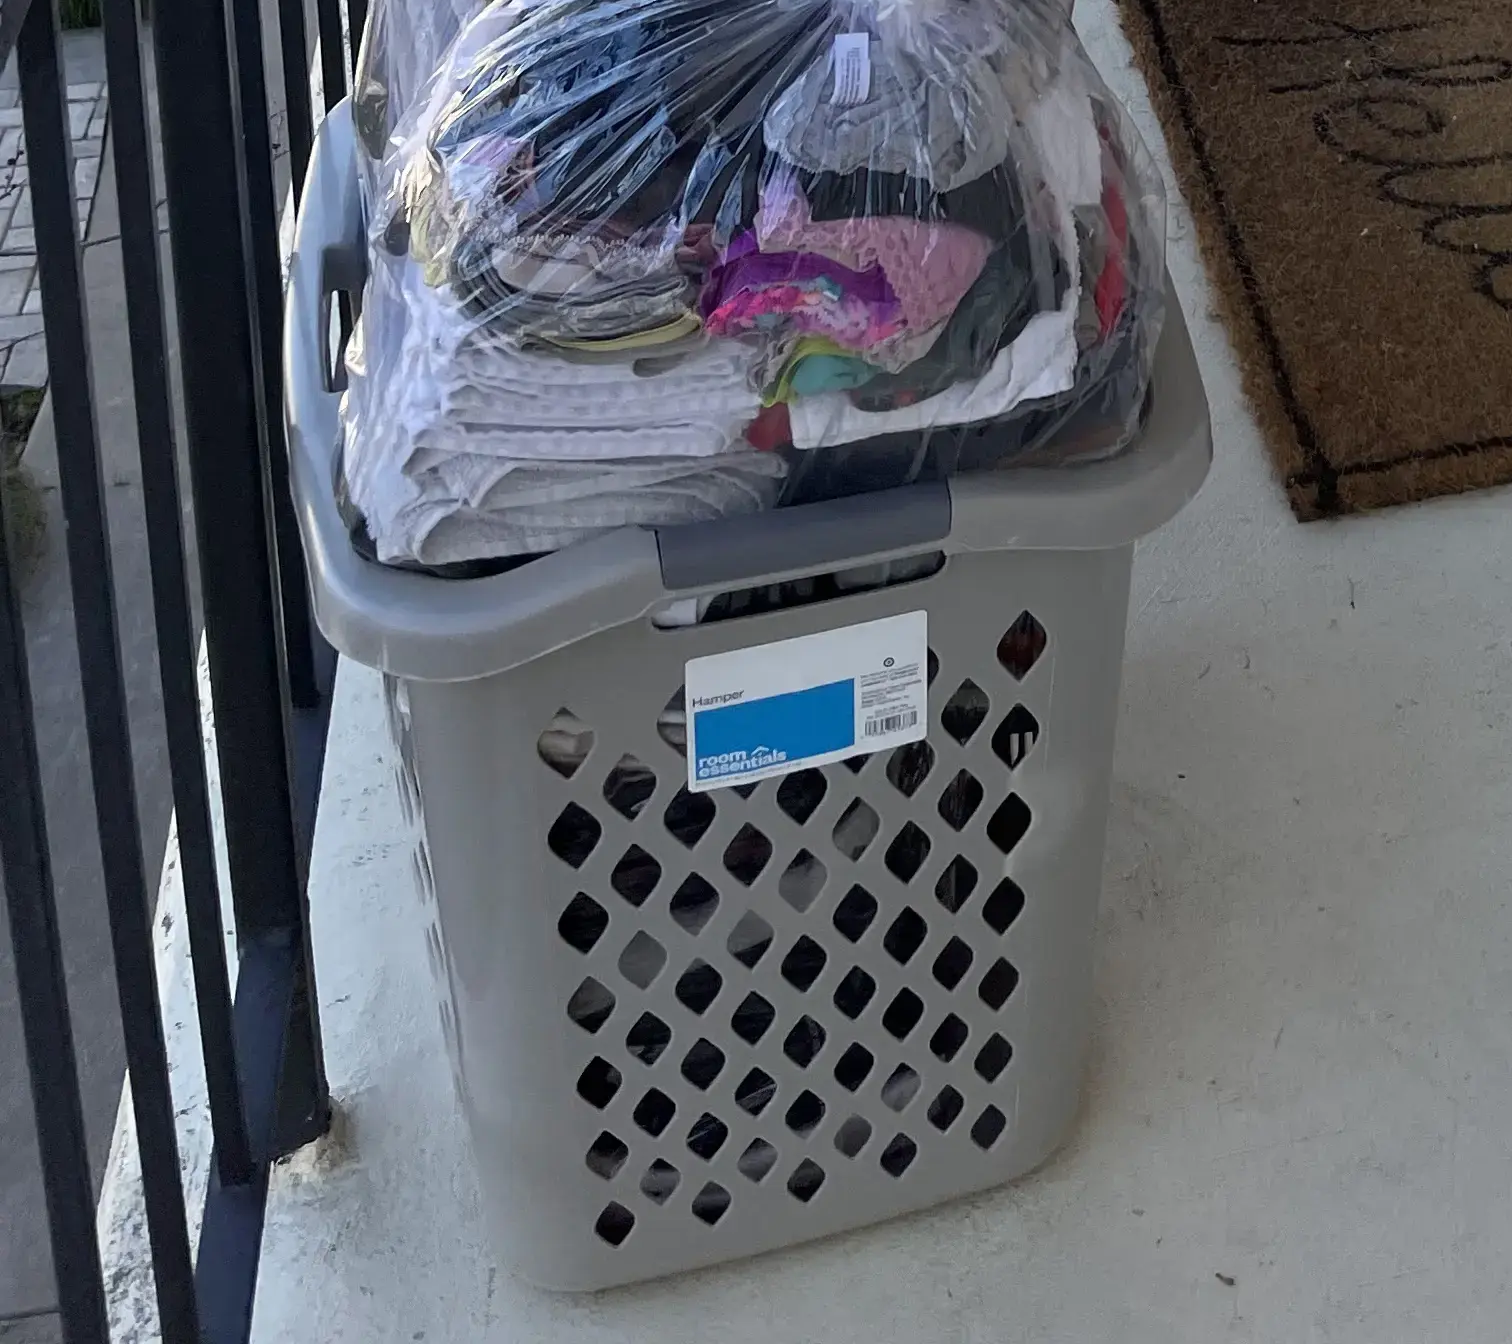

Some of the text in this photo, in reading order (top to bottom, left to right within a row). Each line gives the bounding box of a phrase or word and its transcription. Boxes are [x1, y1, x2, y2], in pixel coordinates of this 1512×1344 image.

[691, 688, 745, 709] Hamper
[699, 750, 747, 768] room
[699, 748, 787, 778] essentials
